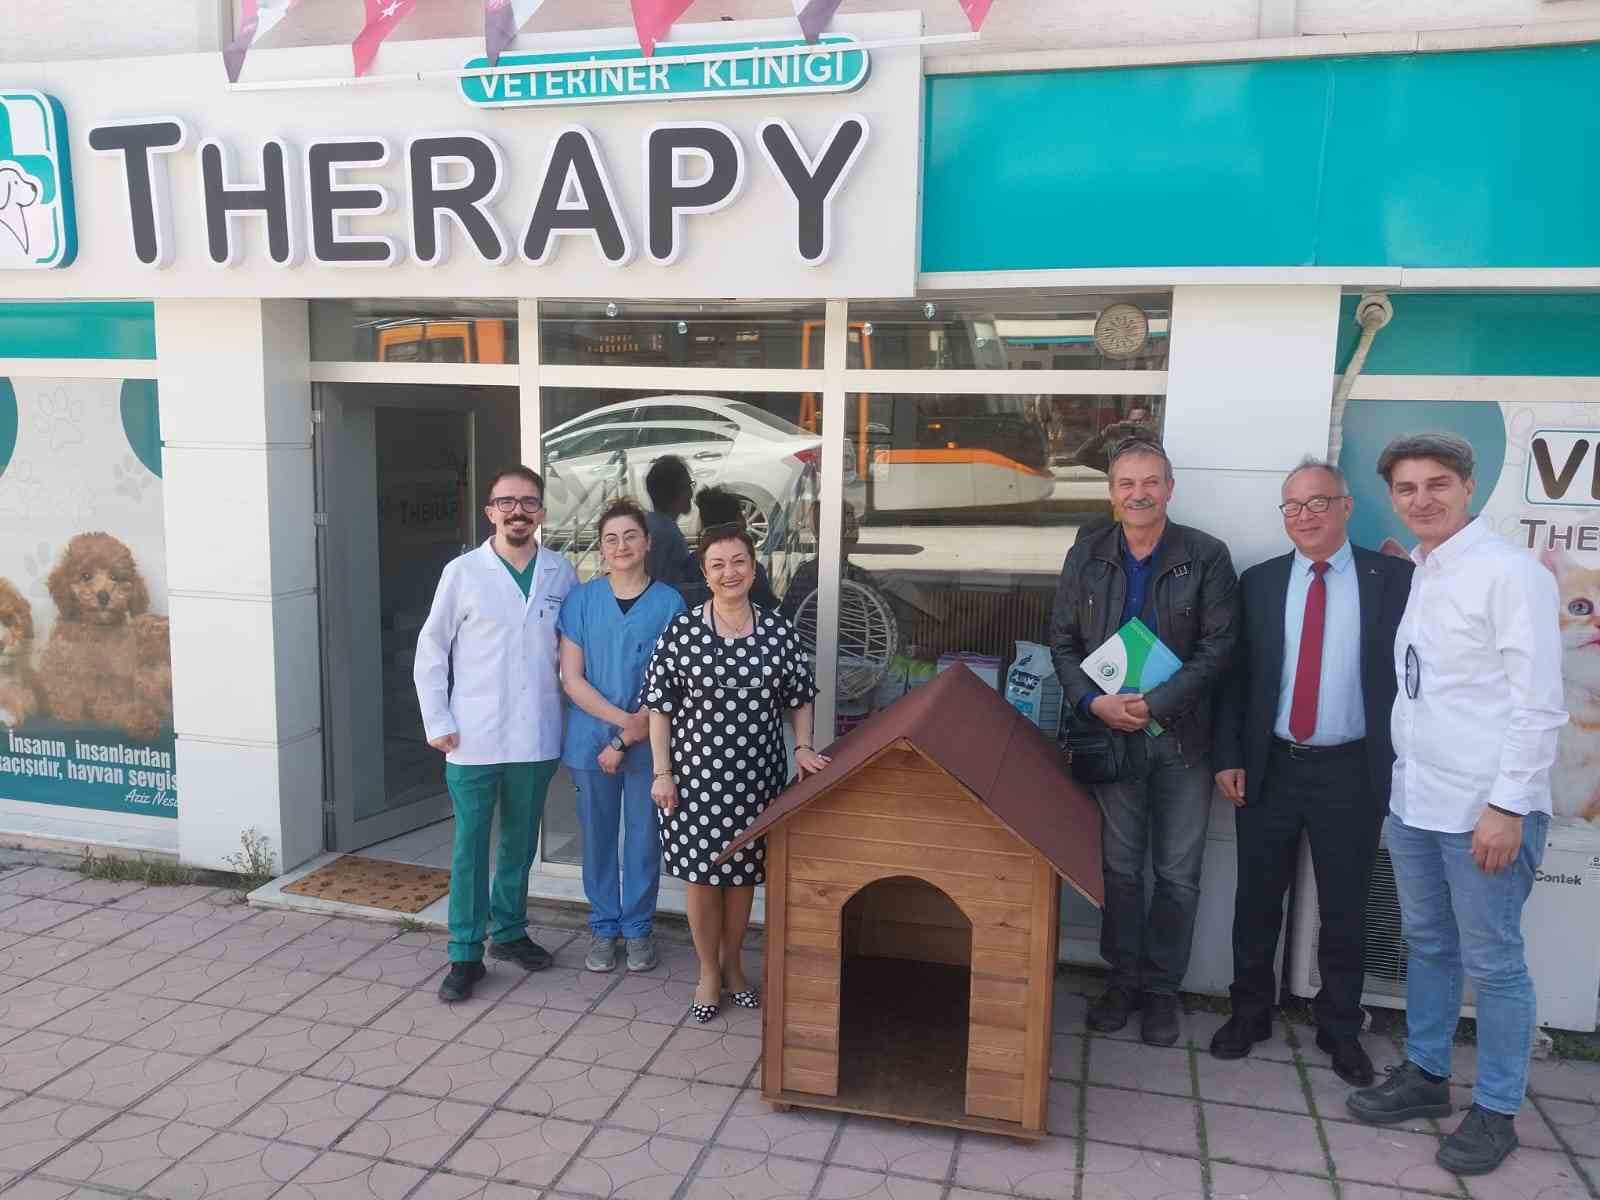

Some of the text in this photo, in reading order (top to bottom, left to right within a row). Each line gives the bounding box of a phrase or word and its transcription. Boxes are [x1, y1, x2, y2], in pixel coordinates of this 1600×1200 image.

[480, 56, 671, 99] VETERİNER
[88, 119, 865, 265] THERAPY
[1531, 438, 1600, 500] V
[1519, 518, 1600, 552] THE
[8, 729, 171, 769] İnsanın insanlardan
[67, 759, 124, 784] hayvan
[124, 788, 151, 804] Aziz
[1535, 869, 1582, 886] Contek
